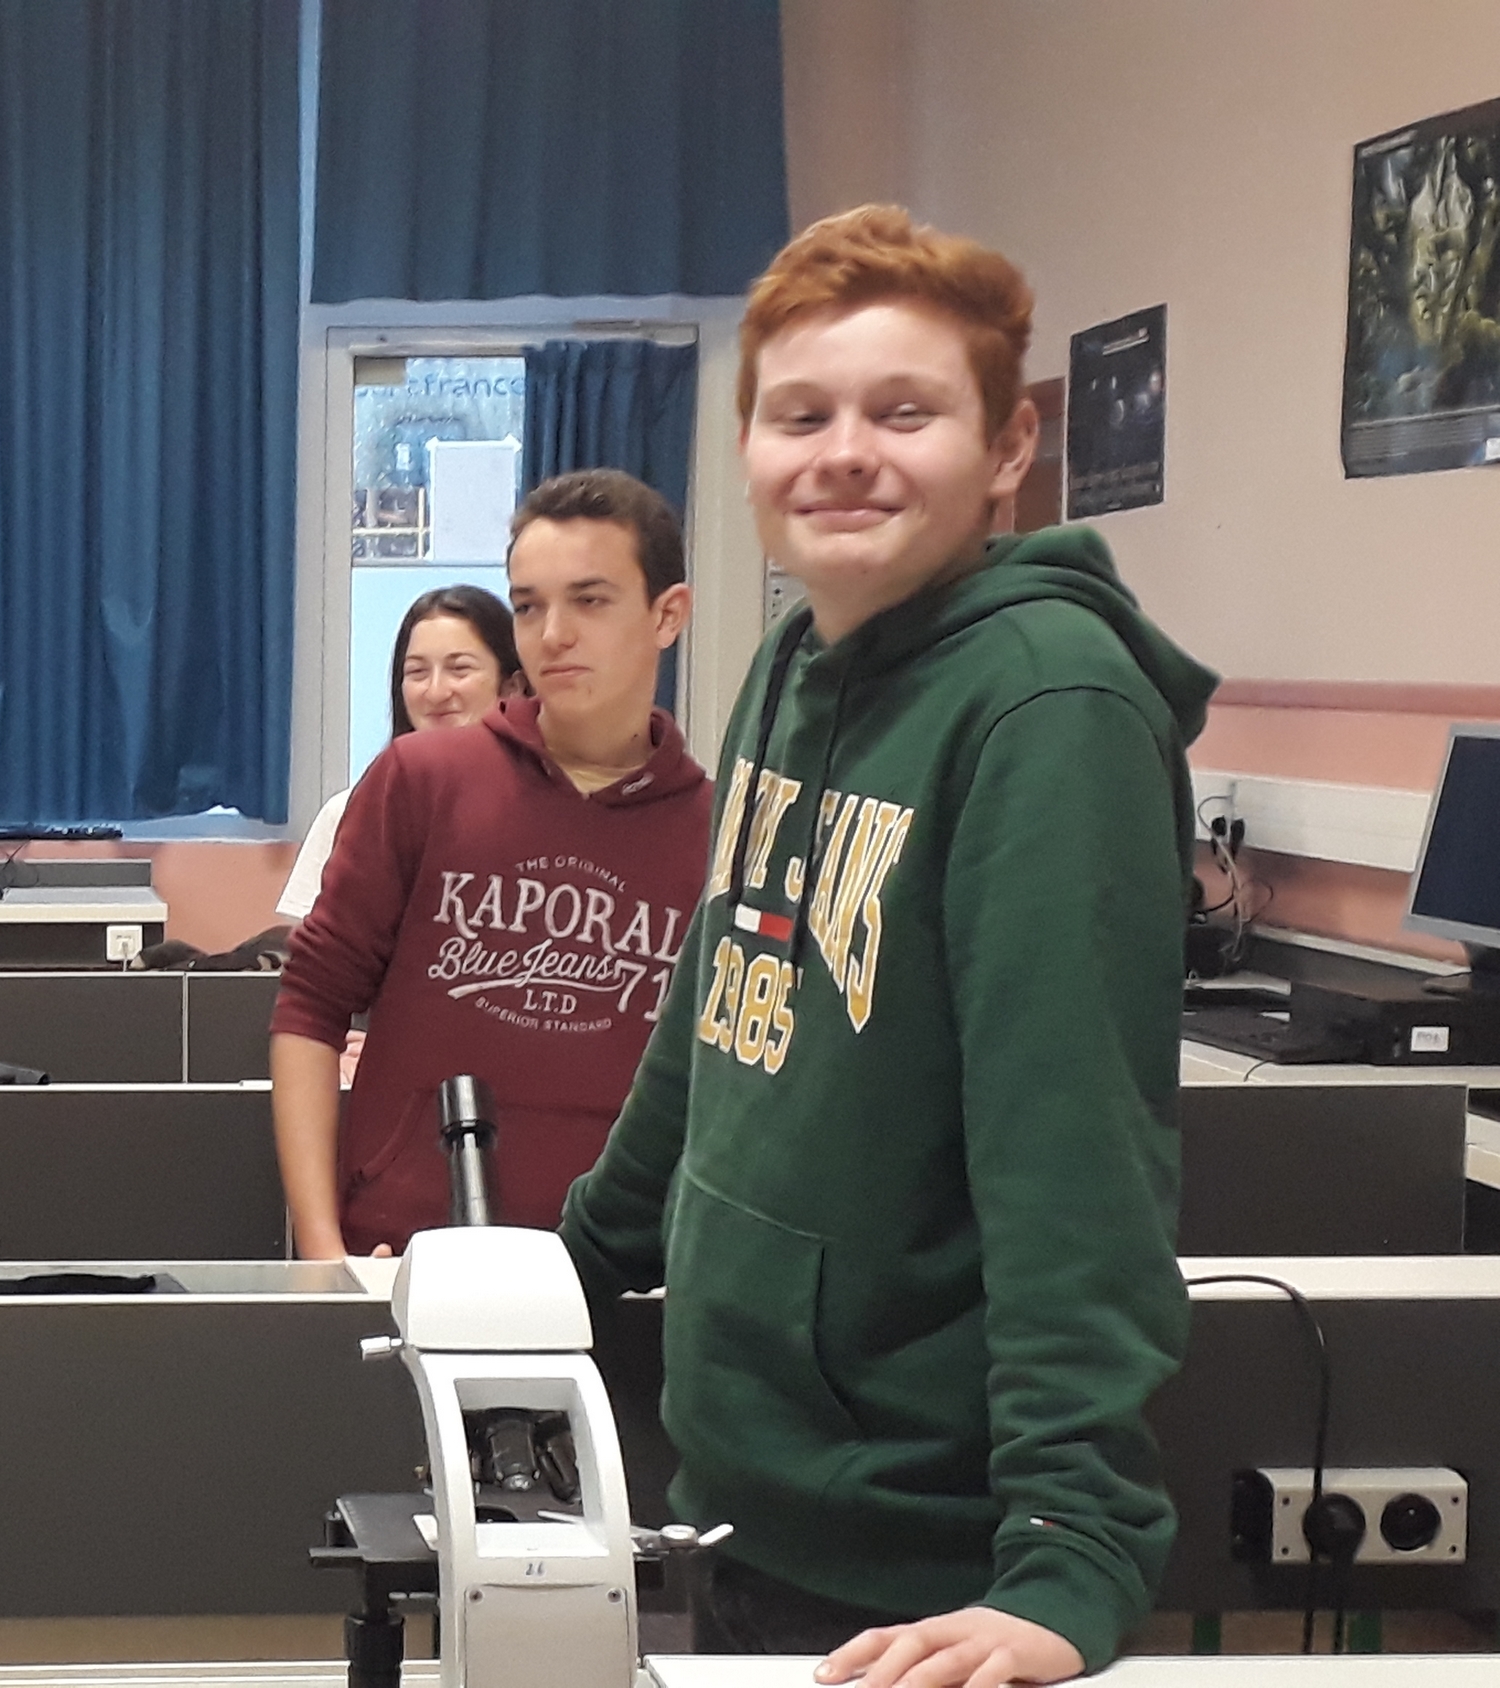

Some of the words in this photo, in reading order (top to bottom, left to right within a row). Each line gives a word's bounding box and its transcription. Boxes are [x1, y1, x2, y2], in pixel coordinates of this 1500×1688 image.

[514, 856, 549, 873] THE
[554, 854, 627, 894] ORIGINAL
[433, 871, 682, 964] KAPORAL
[475, 996, 540, 1030] SUPERIOR
[543, 1017, 613, 1033] STANDARD
[698, 936, 805, 1076] 1985
